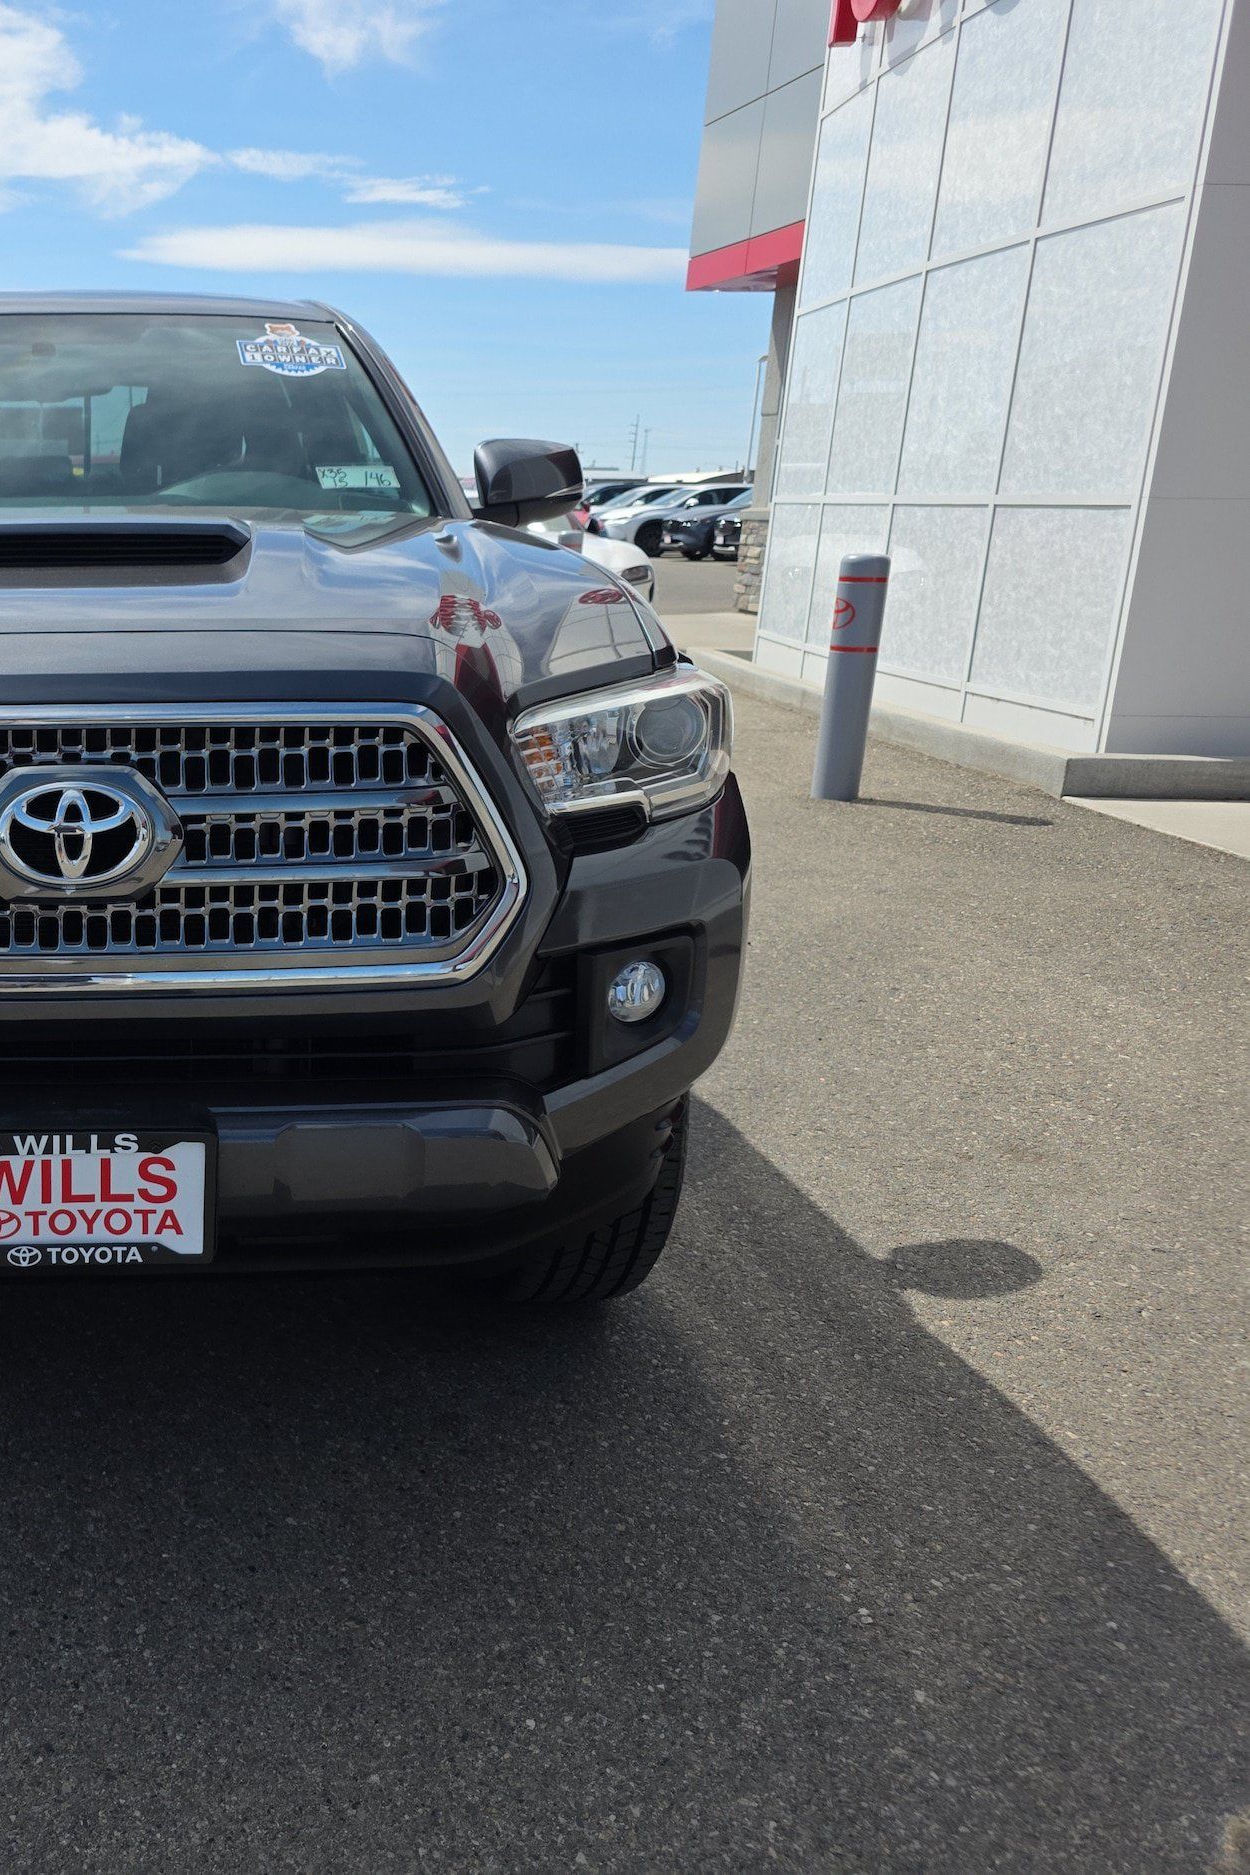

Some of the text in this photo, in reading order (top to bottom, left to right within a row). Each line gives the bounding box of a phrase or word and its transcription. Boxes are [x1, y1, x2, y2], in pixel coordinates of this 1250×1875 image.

[245, 344, 334, 357] CARFAX
[263, 354, 337, 365] OWNER
[365, 470, 391, 487] 146
[13, 1133, 140, 1155] WILLS
[25, 1208, 184, 1236] TOYOTA
[47, 1246, 143, 1264] TOYOTA
